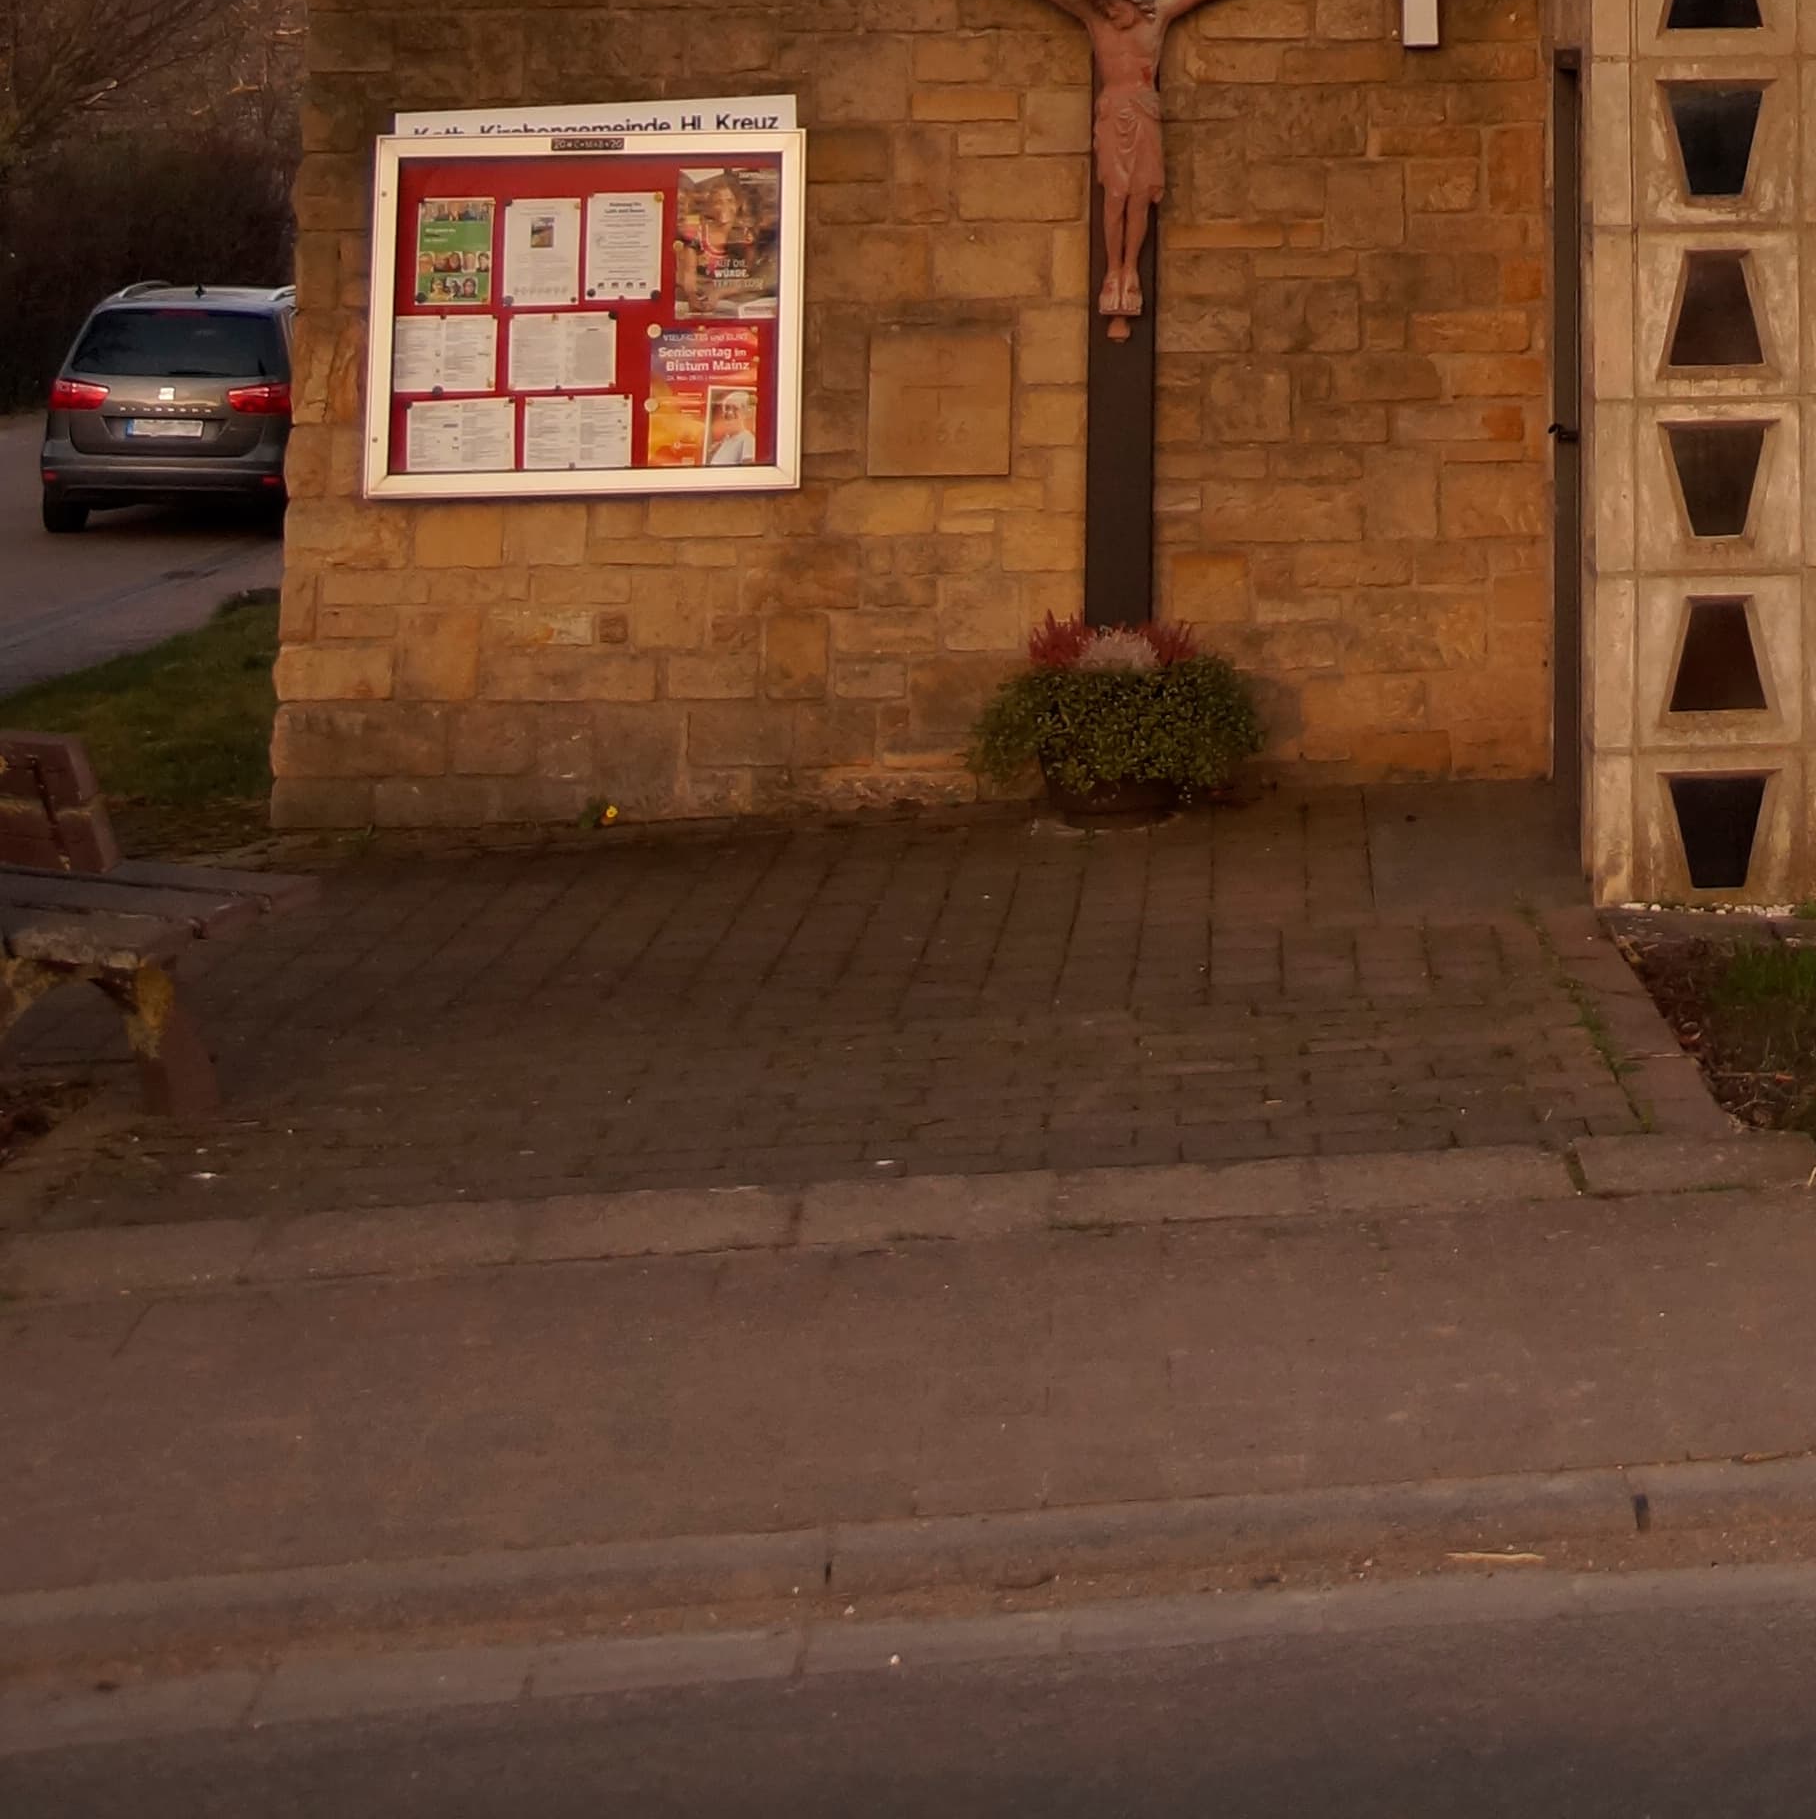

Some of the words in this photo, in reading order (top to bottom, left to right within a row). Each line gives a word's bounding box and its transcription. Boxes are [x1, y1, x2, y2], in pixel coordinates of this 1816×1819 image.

[716, 114, 779, 130] Kreuz
[658, 346, 732, 359] Seniorentag
[666, 360, 710, 372] Bistum
[712, 359, 750, 371] Mainz
